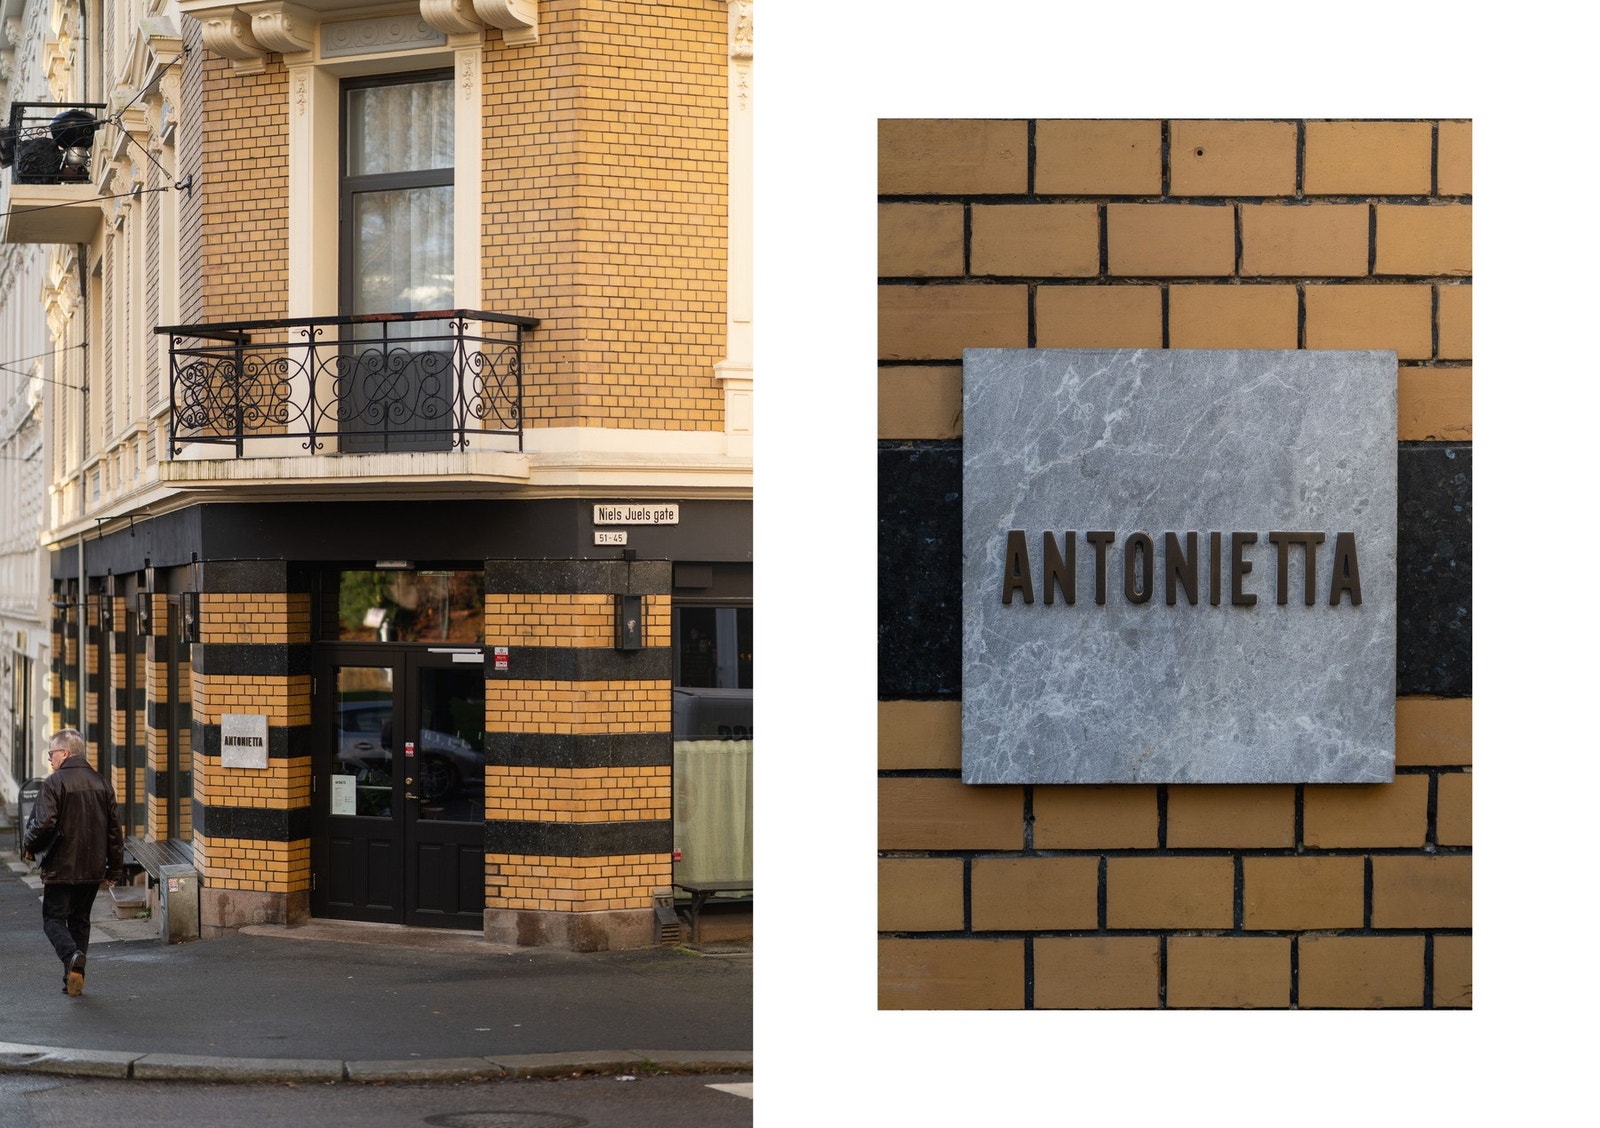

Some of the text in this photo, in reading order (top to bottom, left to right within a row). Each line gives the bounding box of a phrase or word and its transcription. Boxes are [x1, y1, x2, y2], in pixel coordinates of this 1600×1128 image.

[599, 507, 674, 524] Niels Juels gate
[1001, 529, 1363, 605] ANTONIETTA
[224, 735, 263, 747] ANTONIETTA
